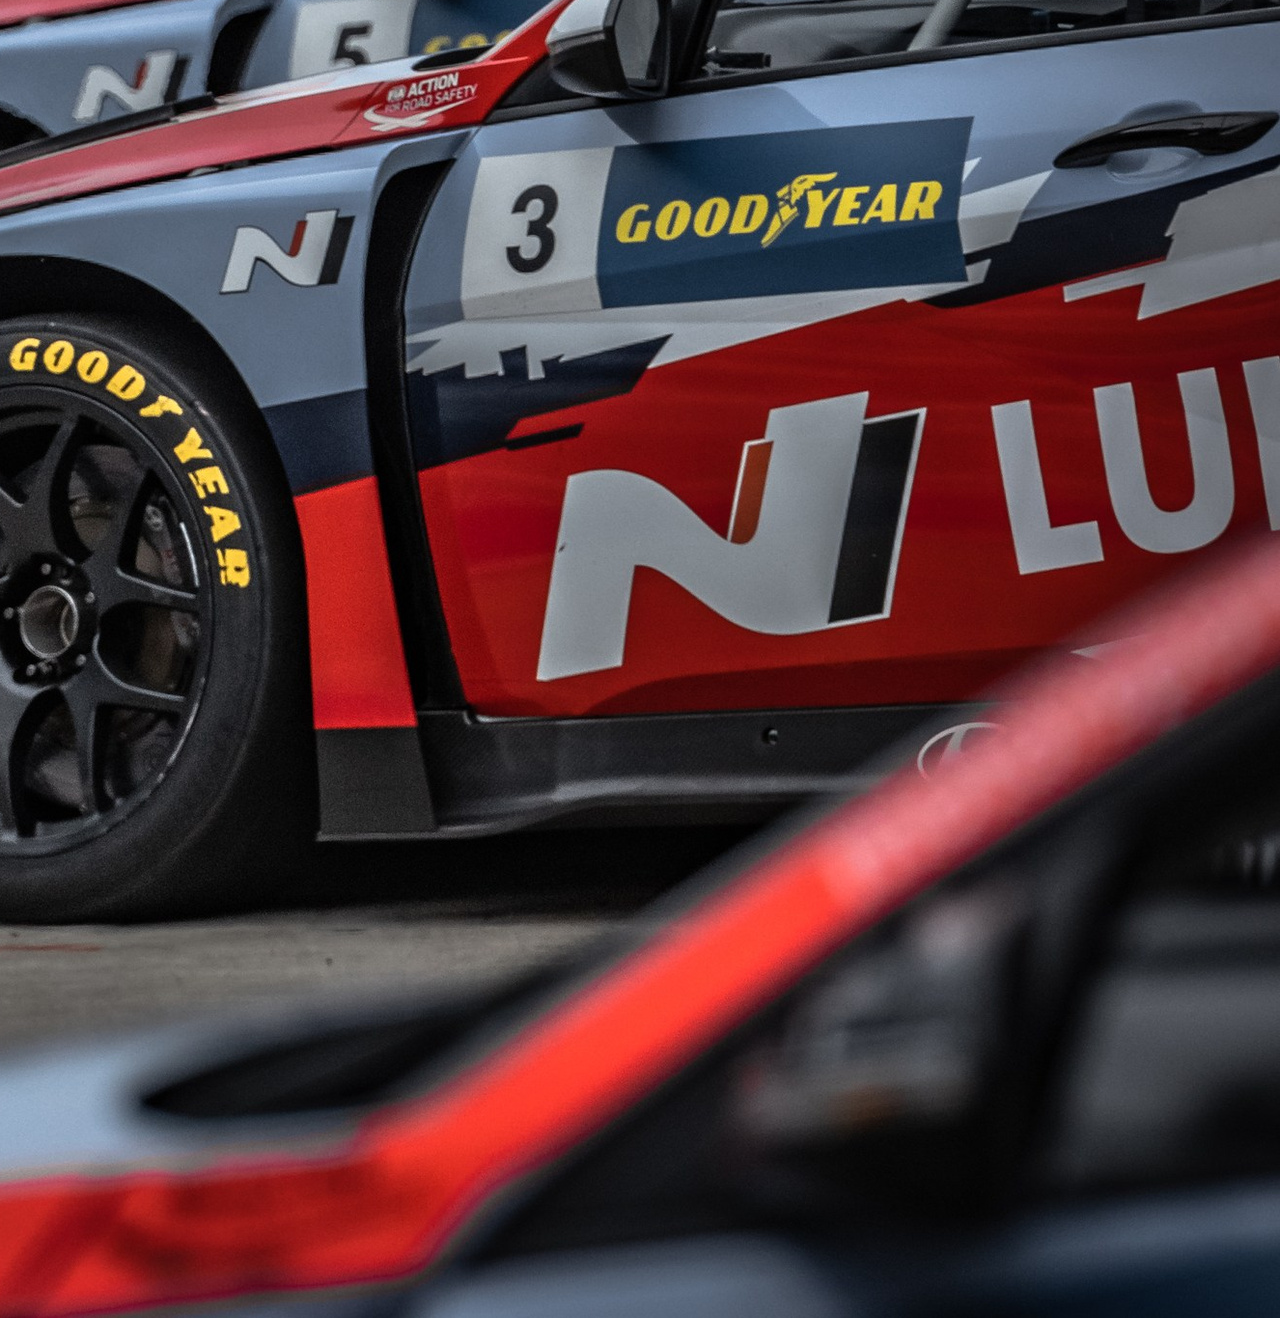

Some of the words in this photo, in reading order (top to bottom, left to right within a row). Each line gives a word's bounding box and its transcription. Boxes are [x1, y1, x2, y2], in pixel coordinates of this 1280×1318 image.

[332, 22, 374, 66] 5
[402, 95, 433, 112] ROAD
[434, 83, 478, 104] SAFETY
[407, 72, 460, 99] ACTION
[505, 184, 558, 274] 3
